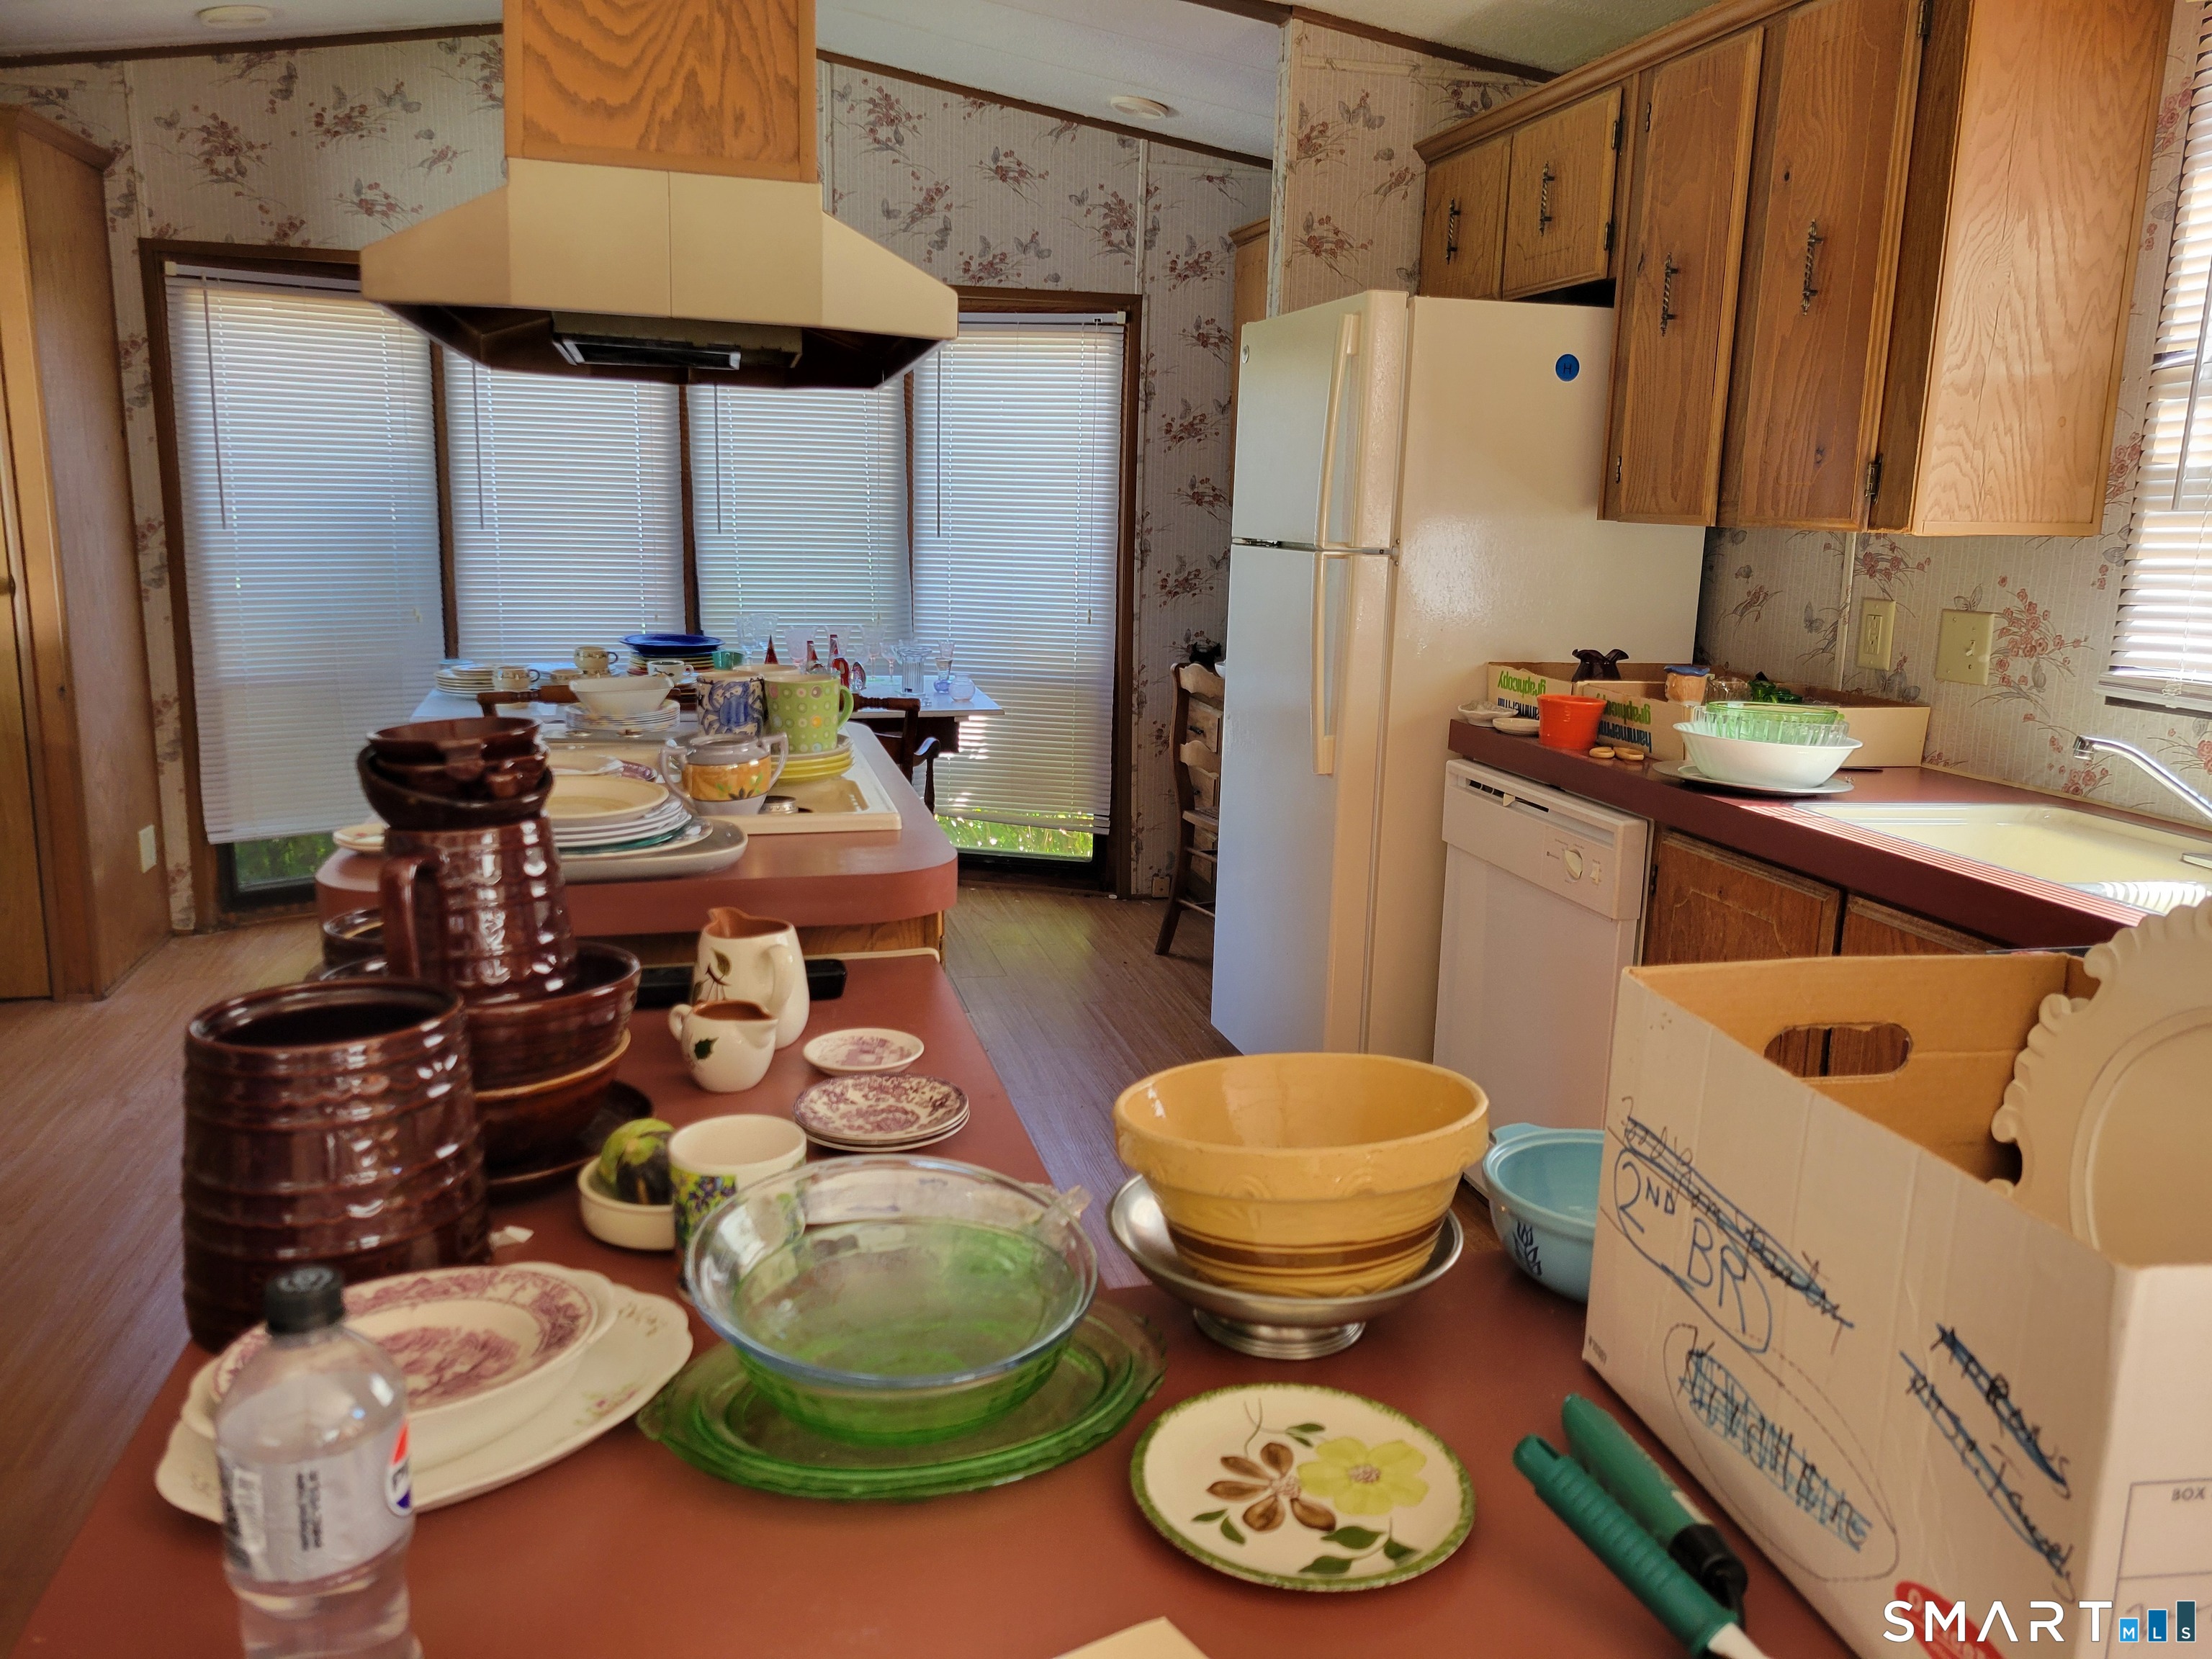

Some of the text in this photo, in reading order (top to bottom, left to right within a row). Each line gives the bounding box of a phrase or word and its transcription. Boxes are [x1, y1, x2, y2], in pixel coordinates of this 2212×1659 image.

[1563, 363, 1572, 374] H
[1497, 697, 1539, 721] ammermill
[1596, 693, 1651, 724] graphico
[1597, 720, 1652, 754] hammerm
[1618, 1161, 1746, 1334] 2ND BR
[2171, 1486, 2206, 1501] BOX
